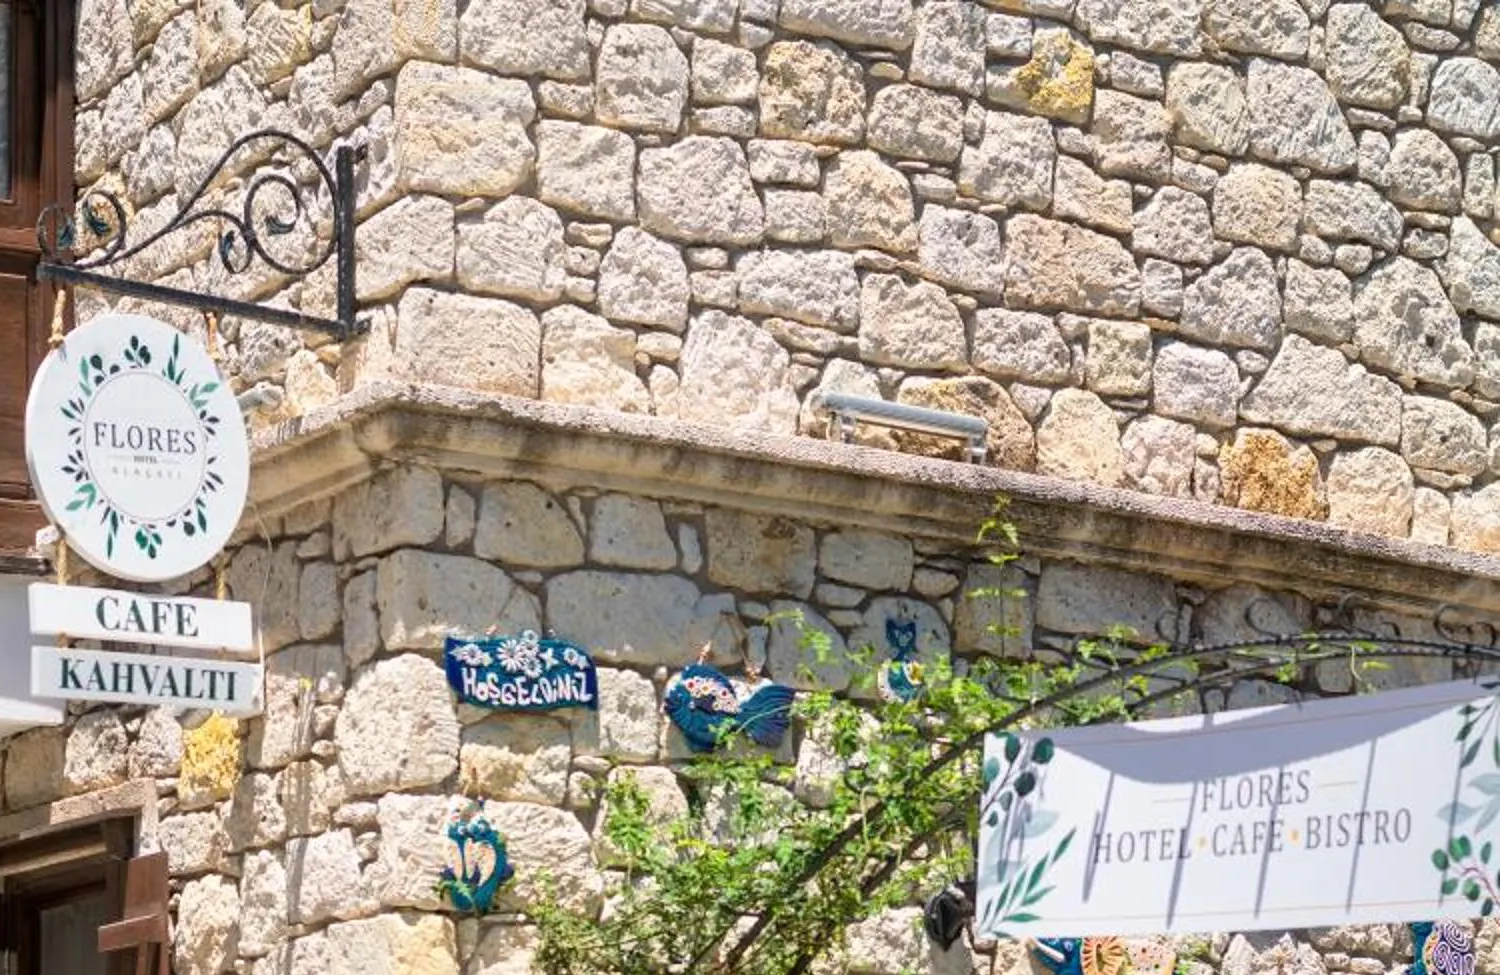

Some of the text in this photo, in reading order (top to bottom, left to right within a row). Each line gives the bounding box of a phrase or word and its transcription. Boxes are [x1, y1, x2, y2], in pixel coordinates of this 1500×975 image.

[93, 421, 197, 455] FLORES
[95, 596, 199, 637] CAFE
[59, 657, 238, 701] KAHVALTI
[1202, 769, 1311, 812] FLORES
[1093, 807, 1412, 865] HOTEL CAFE BISTRO
